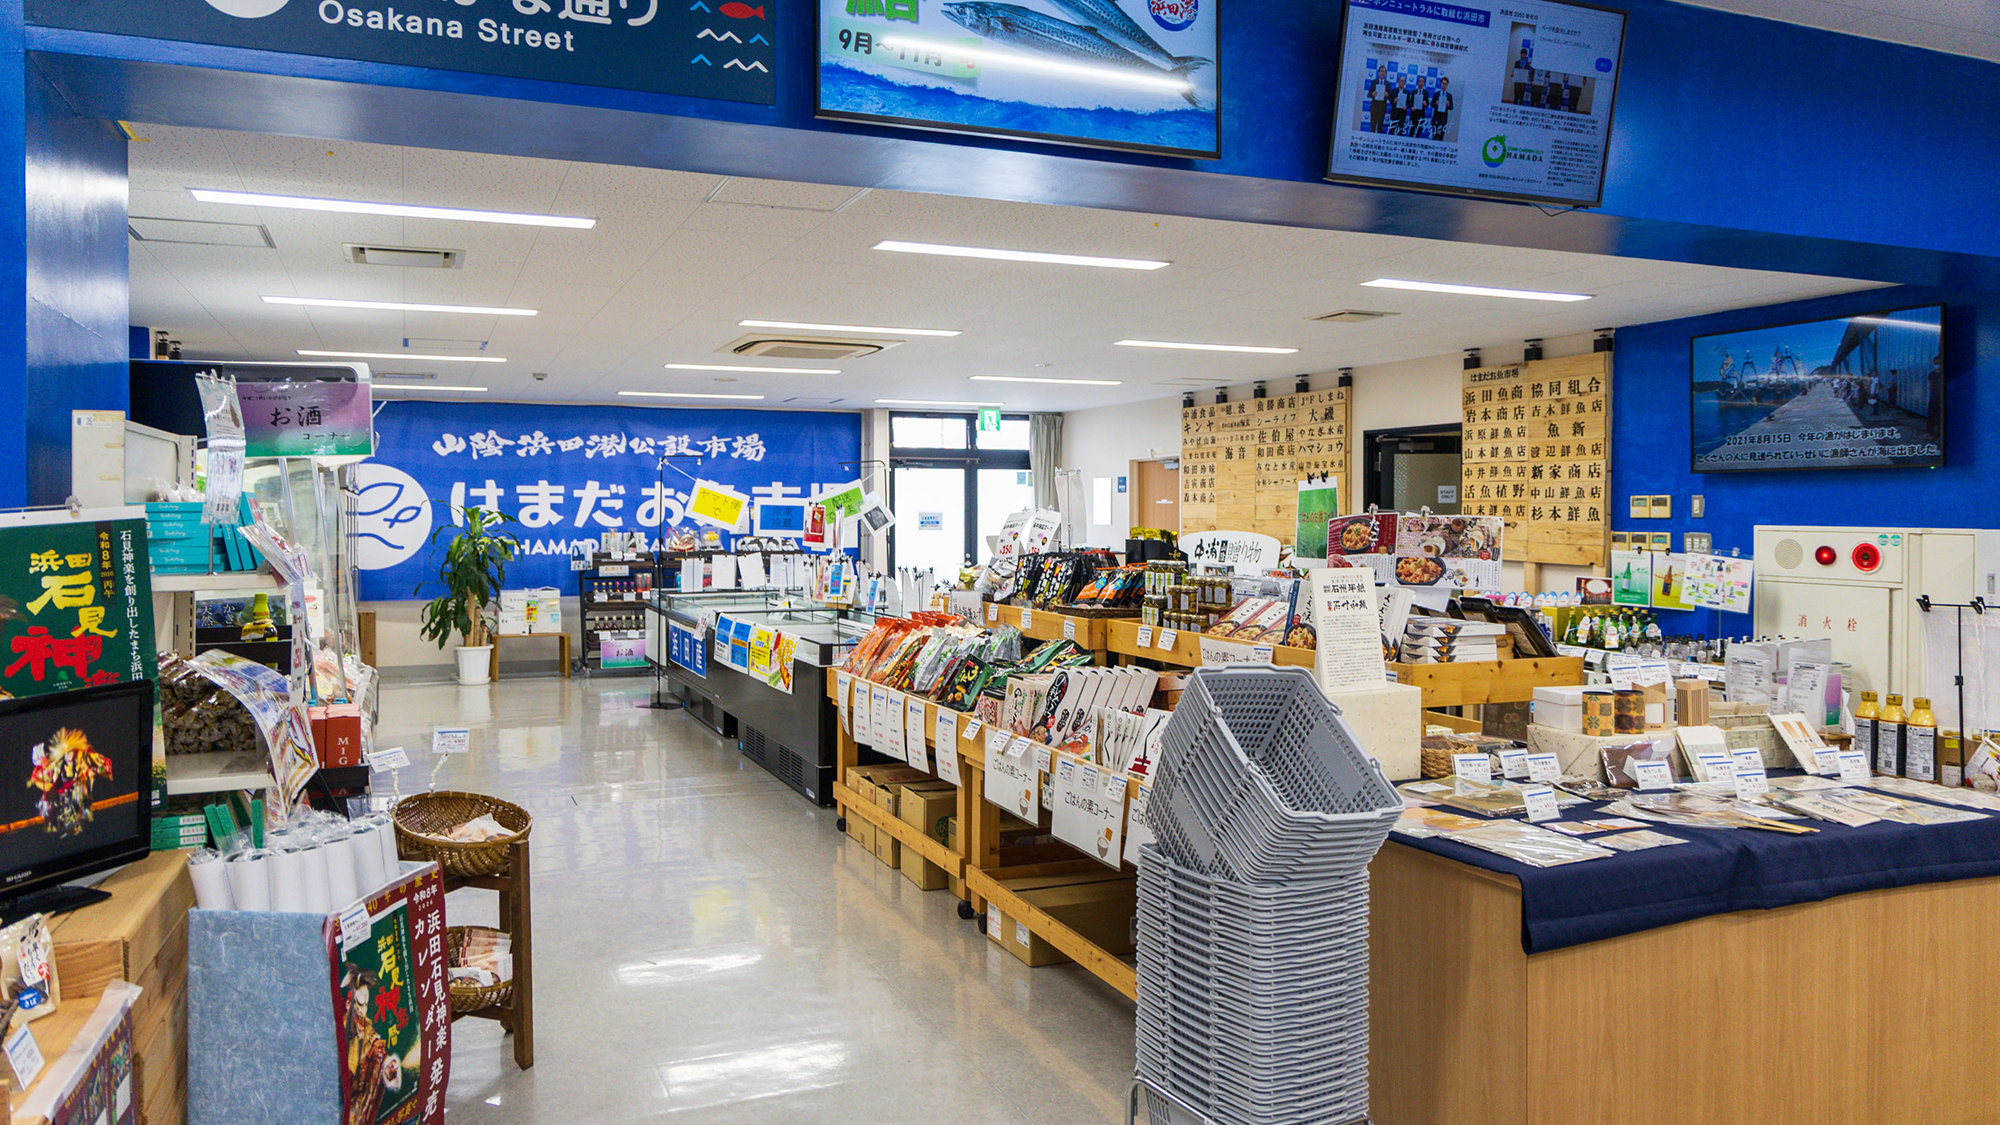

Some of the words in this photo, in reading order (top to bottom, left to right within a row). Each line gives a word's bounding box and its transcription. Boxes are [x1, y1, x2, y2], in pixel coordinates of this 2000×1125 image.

[318, 0, 463, 39] Osakana
[477, 18, 575, 52] Street
[1506, 151, 1543, 163] HAMADA
[1470, 368, 1519, 382] はまだお魚市場
[1465, 385, 1523, 405] 浜田魚商
[1531, 377, 1601, 398] 協同組合
[270, 405, 322, 427] お酒
[1183, 406, 1216, 420] 中浦食品
[1257, 413, 1297, 426] シーライフ
[1465, 405, 1525, 423] 岩本商店
[1184, 420, 1214, 434] キンヤ
[1464, 425, 1526, 440] 浜原鮮魚店
[1548, 421, 1586, 438] 魚新
[303, 431, 350, 440] コーナー
[1726, 433, 1792, 446] 2021年8月15日
[1257, 445, 1296, 458] 和田商店
[1299, 440, 1343, 453] ハマショウ
[1531, 442, 1602, 458] 渡辺鮮魚店
[1464, 465, 1526, 479] 中井鮮魚店
[1531, 462, 1601, 479] 新家商店
[1464, 483, 1525, 498] 活魚植野
[1531, 486, 1602, 499] 中山鮮魚店
[450, 480, 857, 530] はまだお
[700, 488, 742, 513] ヤマト便
[771, 505, 793, 516] 冷凍
[1531, 505, 1600, 521] 杉本鮮魚
[771, 517, 793, 529] 冷蔵
[99, 531, 112, 569] 令和8年
[29, 549, 92, 574] 浜田
[119, 529, 143, 681] 石見神楽を創り出したまち浜田
[1798, 613, 1859, 633] 消火栓
[993, 758, 1032, 783] ごはんの素コーナー
[1064, 791, 1115, 820] ごはんの素コーナー
[6, 871, 32, 883] SHARP
[413, 885, 438, 905] 令和8年
[415, 918, 433, 1059] カレンダー
[427, 910, 447, 1052] 浜田石見神楽
[423, 1059, 444, 1122] 発売
